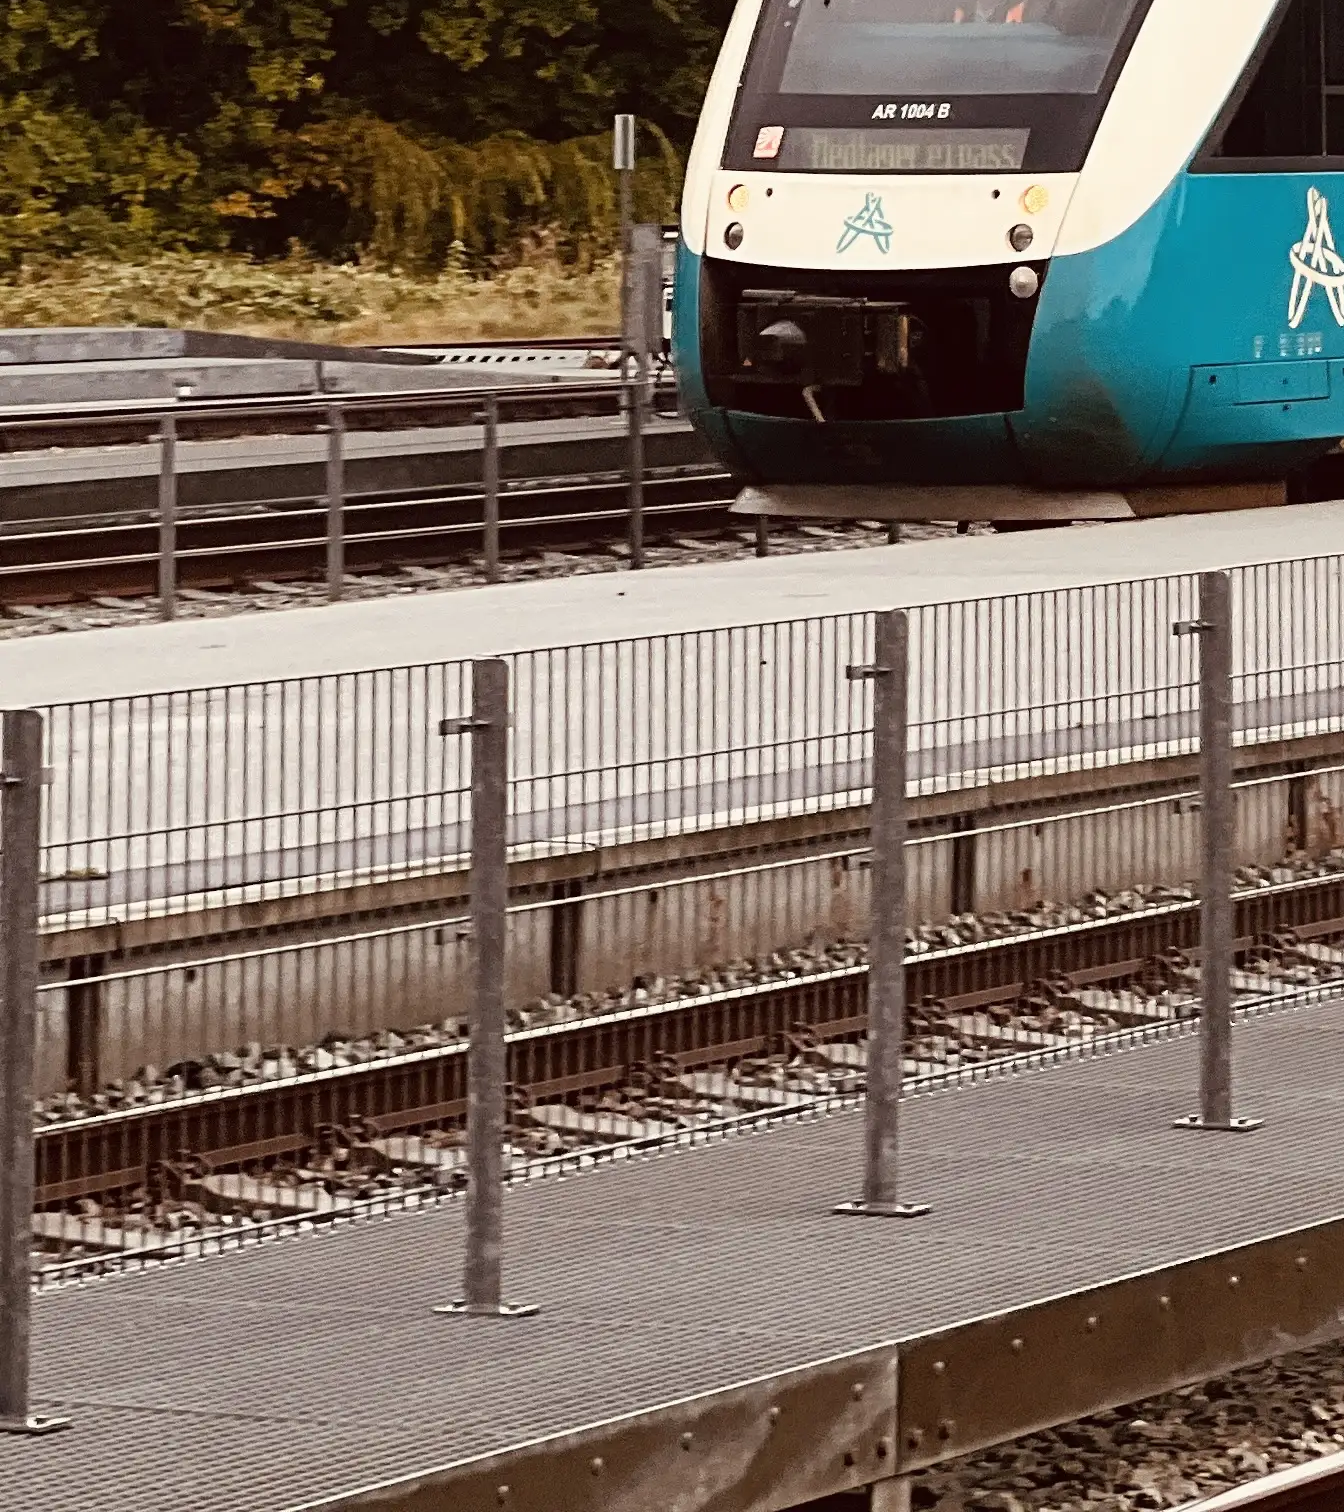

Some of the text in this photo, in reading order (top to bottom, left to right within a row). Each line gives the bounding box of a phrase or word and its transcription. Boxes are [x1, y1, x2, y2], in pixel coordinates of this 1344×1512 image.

[871, 102, 951, 120] AR 1004 B
